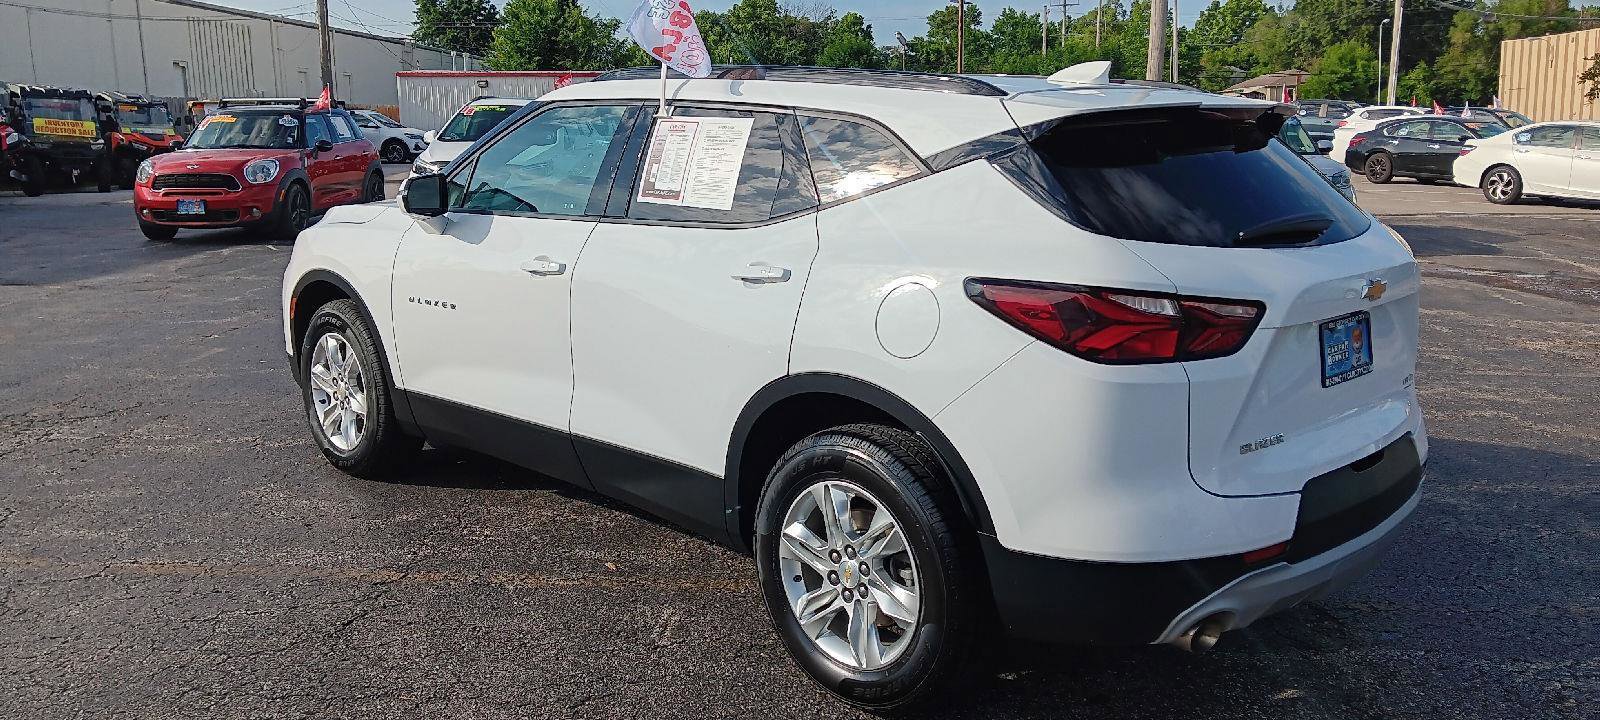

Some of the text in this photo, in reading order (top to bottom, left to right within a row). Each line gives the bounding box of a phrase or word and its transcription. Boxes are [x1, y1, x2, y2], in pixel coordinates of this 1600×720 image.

[44, 119, 84, 128] INVENTORY
[35, 126, 76, 135] REDUCTION
[408, 296, 457, 310] BLAZER
[1240, 433, 1285, 455] BLAZER
